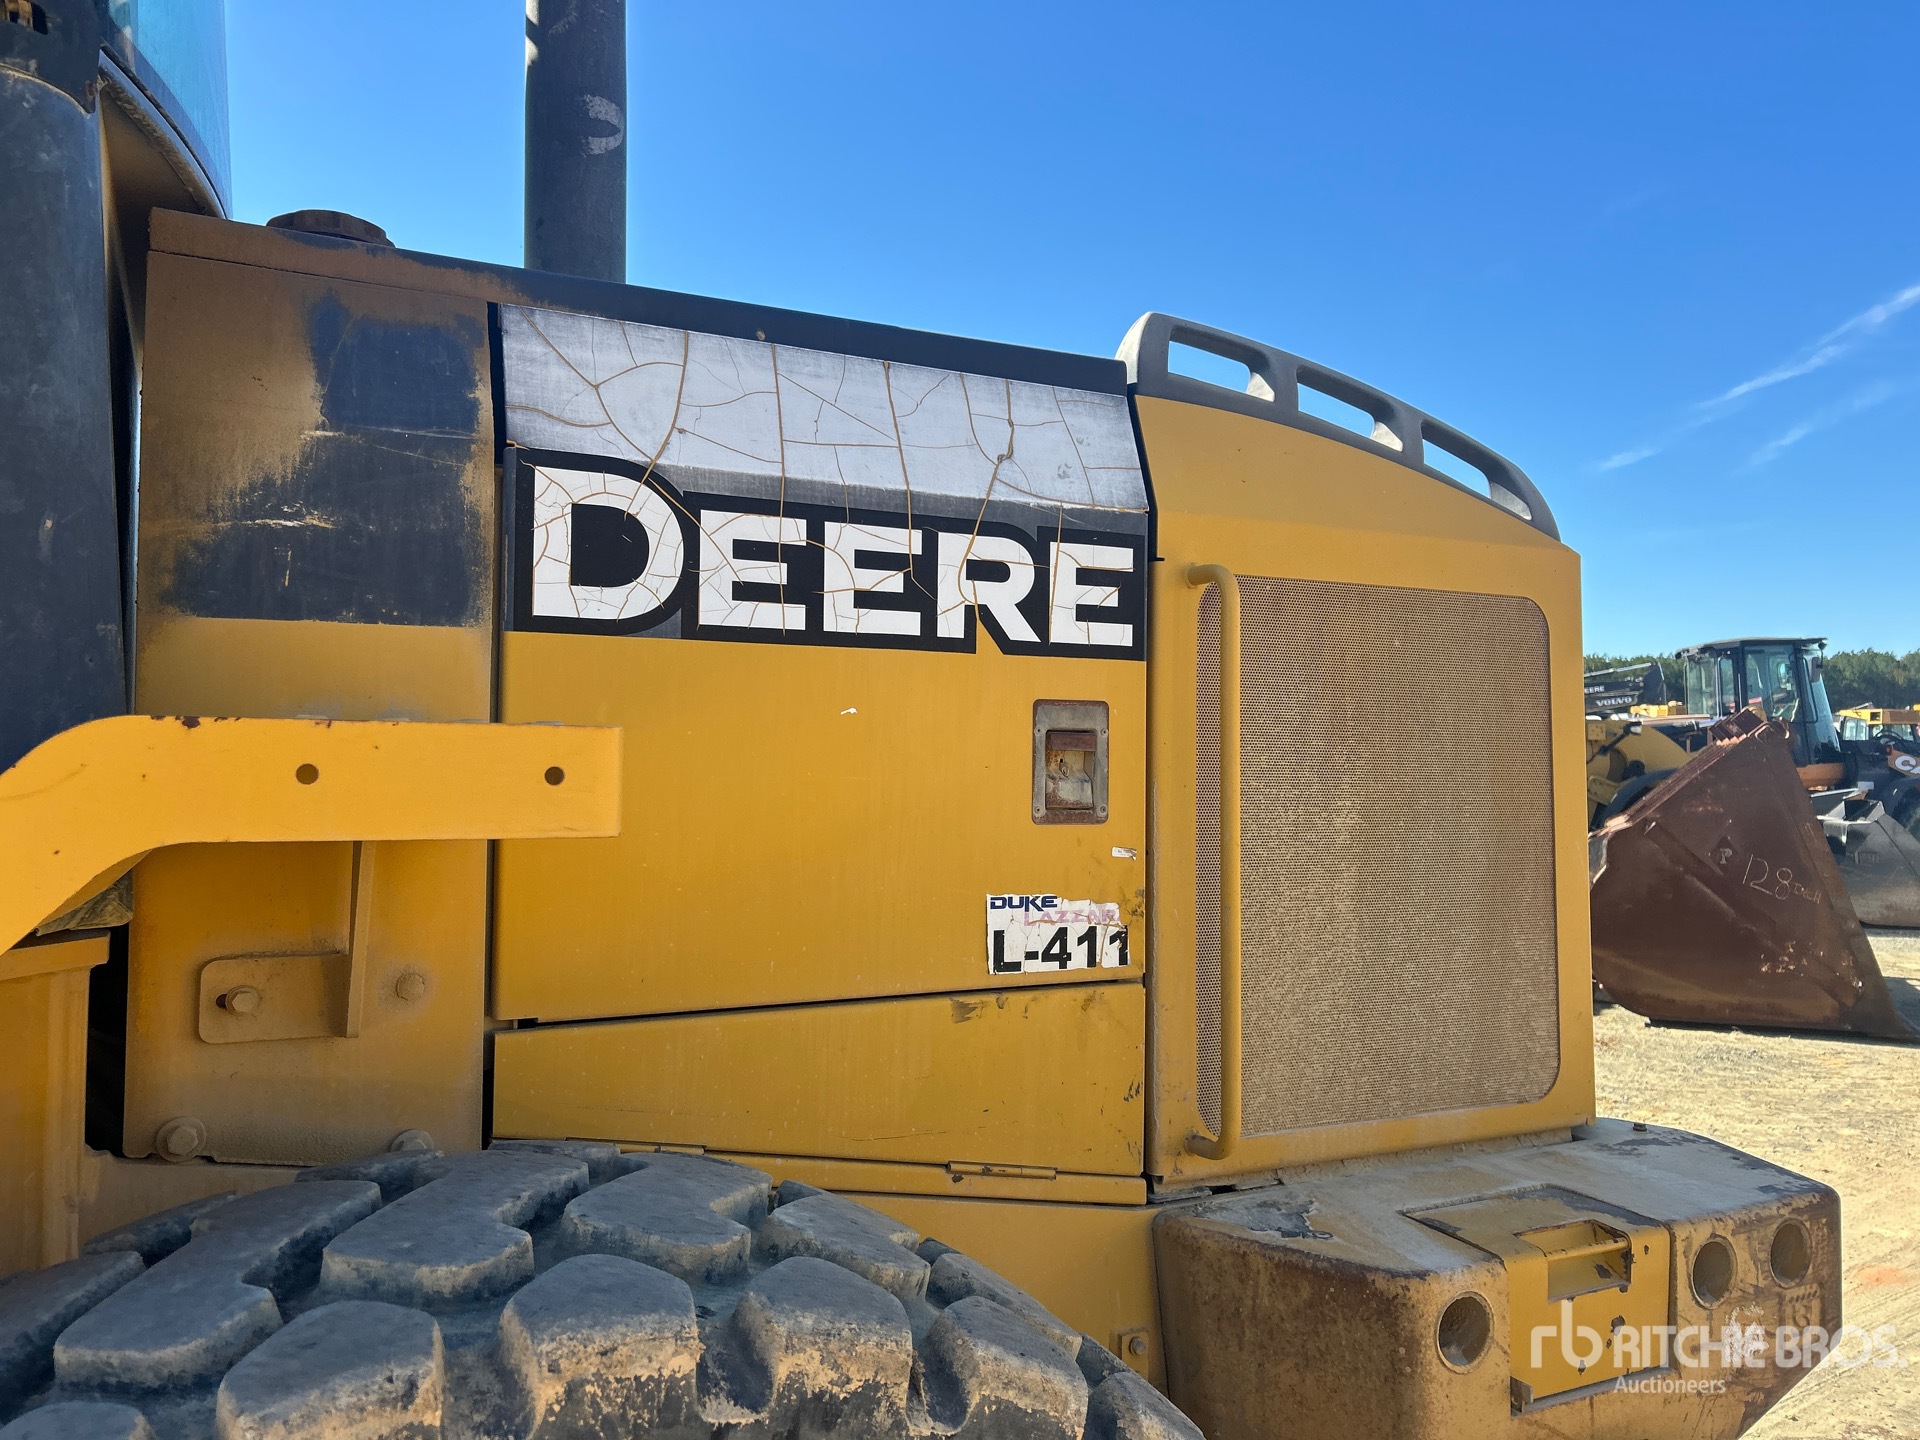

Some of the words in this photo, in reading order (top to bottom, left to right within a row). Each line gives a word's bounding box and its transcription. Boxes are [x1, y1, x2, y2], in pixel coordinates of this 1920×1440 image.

[533, 465, 1134, 648] DEERE
[1596, 696, 1632, 706] VOLVO
[1743, 854, 1792, 900] 128
[990, 896, 1058, 912] DUKE
[1024, 908, 1121, 926] LAZZAR
[993, 925, 1129, 973] L-411
